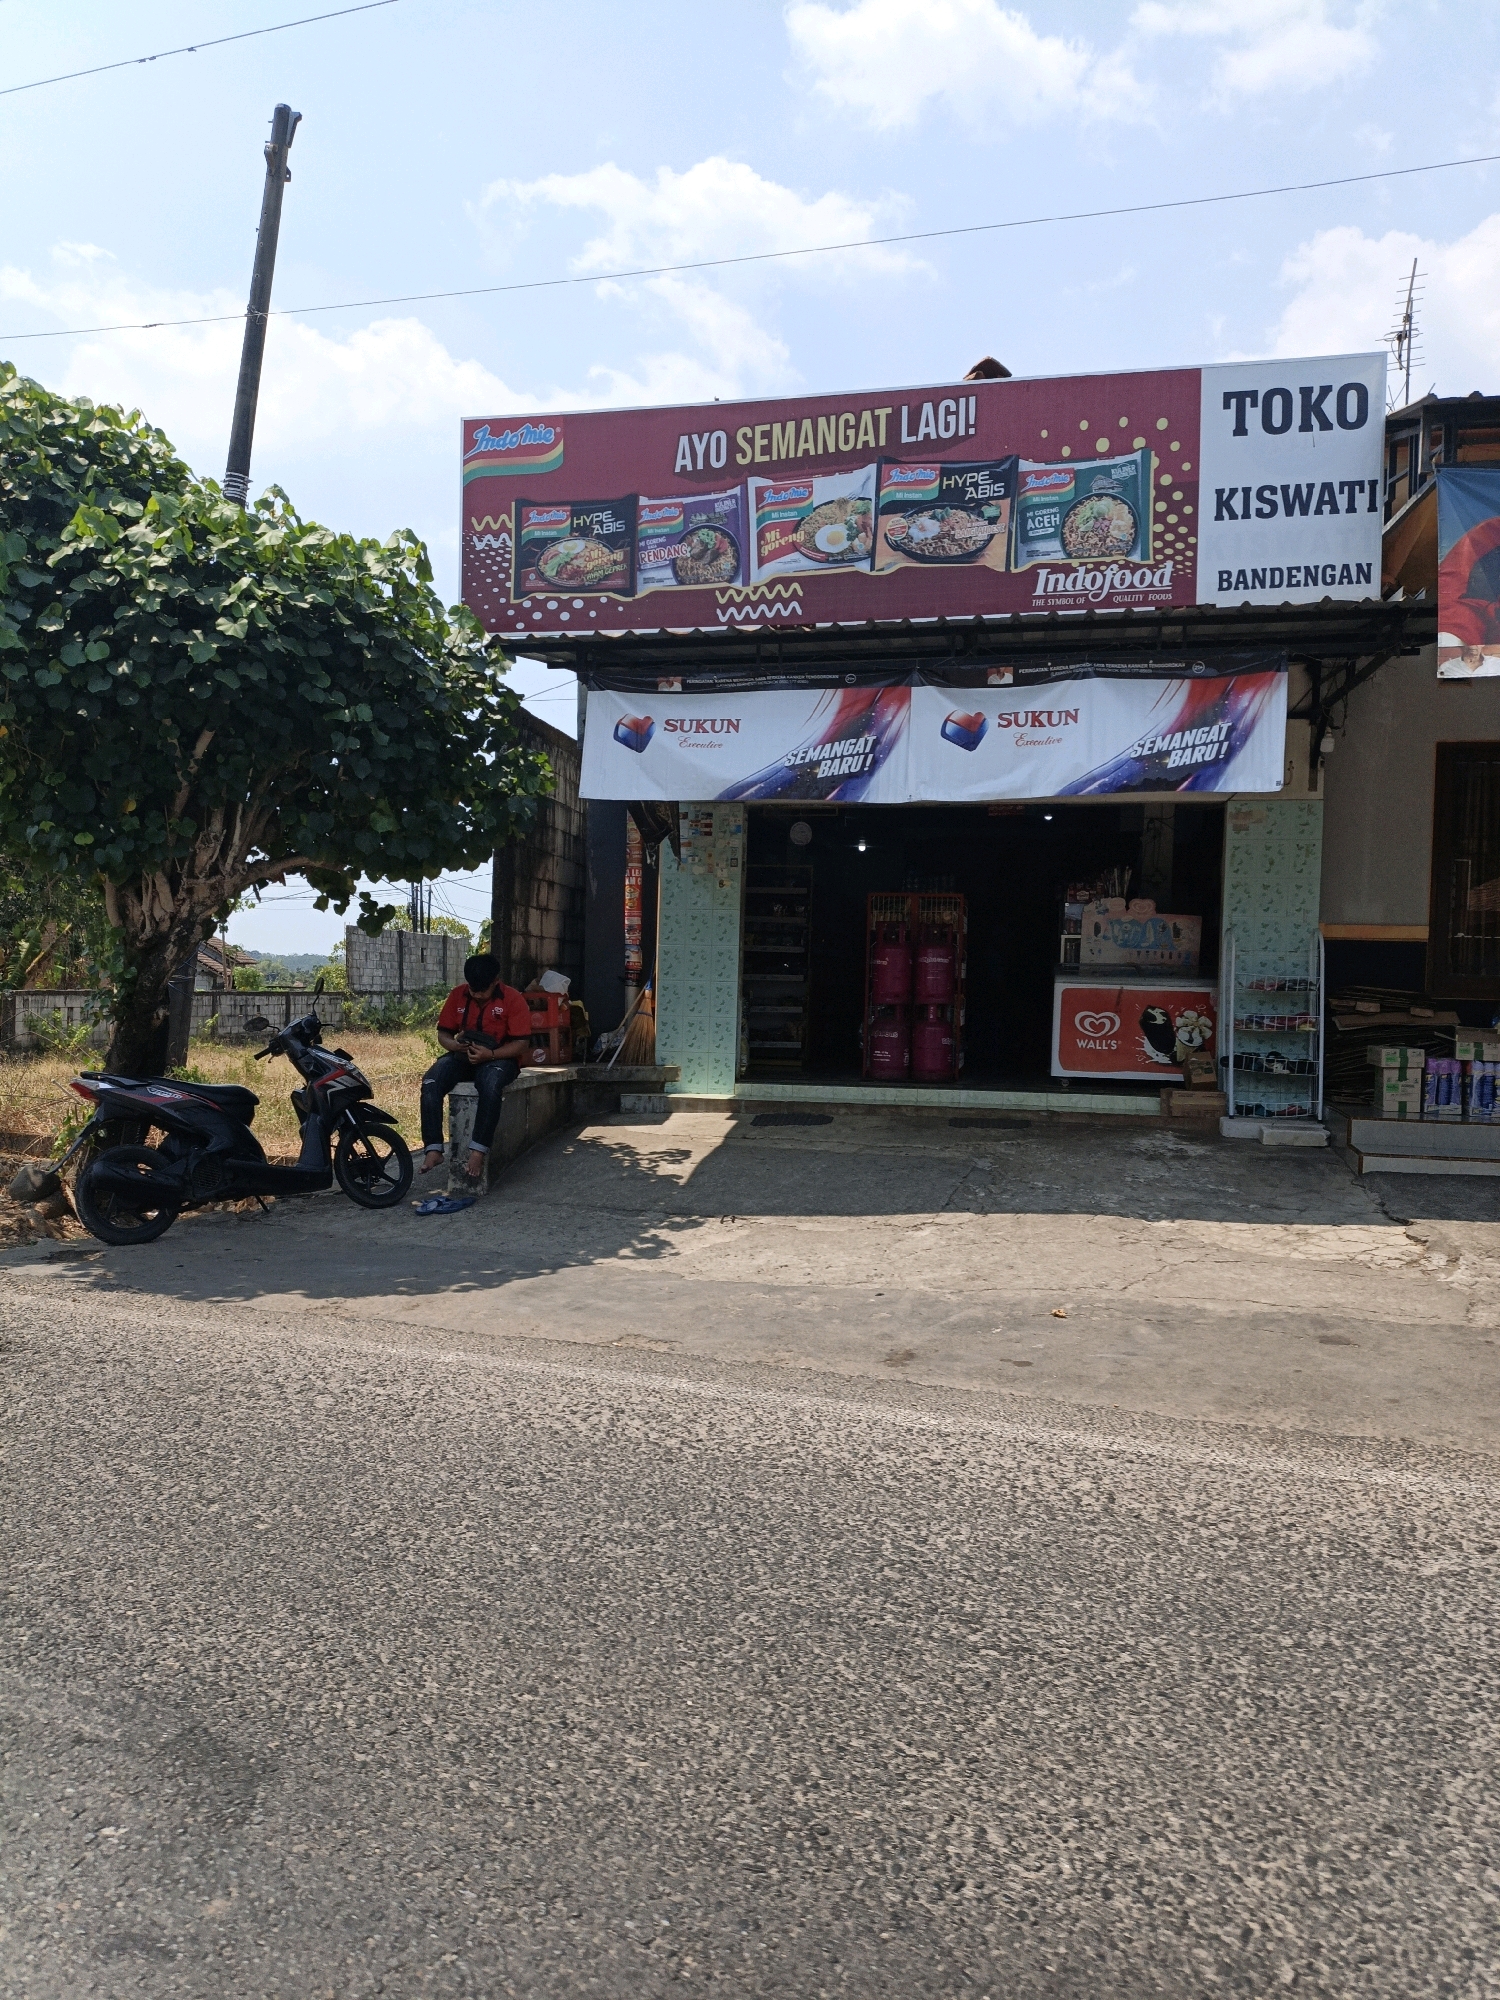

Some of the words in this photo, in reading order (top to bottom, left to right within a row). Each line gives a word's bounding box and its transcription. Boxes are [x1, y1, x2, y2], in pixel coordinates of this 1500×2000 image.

[1222, 382, 1369, 437] TOKO
[674, 430, 727, 473] AYO
[735, 406, 892, 465] SEMANGAT
[900, 395, 977, 443] LAGI!
[942, 471, 994, 490] HYPE
[964, 482, 1005, 500] ABIS
[1213, 479, 1378, 521] KISWATI
[573, 510, 616, 528] HYPE
[591, 520, 626, 536] ABIS
[1026, 514, 1060, 530] ACEH
[761, 530, 805, 556] goreng
[765, 528, 781, 542] Mi
[639, 543, 688, 564] RENDANG
[1032, 561, 1175, 602] Indofood
[1217, 562, 1373, 592] BANDENGAN
[1032, 599, 1046, 607] THE
[1047, 597, 1075, 606] SYMBOL
[1076, 596, 1086, 604] OF
[1113, 594, 1144, 603] QUALITY
[1148, 593, 1173, 601] FOODS
[663, 718, 742, 734] SUKUN
[997, 708, 1080, 730] SUKUN
[677, 735, 724, 750] Executive
[1013, 731, 1064, 748] Executive
[1130, 721, 1233, 759] SEMANGAT
[784, 735, 877, 768] SEMANGAT
[1076, 1038, 1118, 1050] WALL'S
